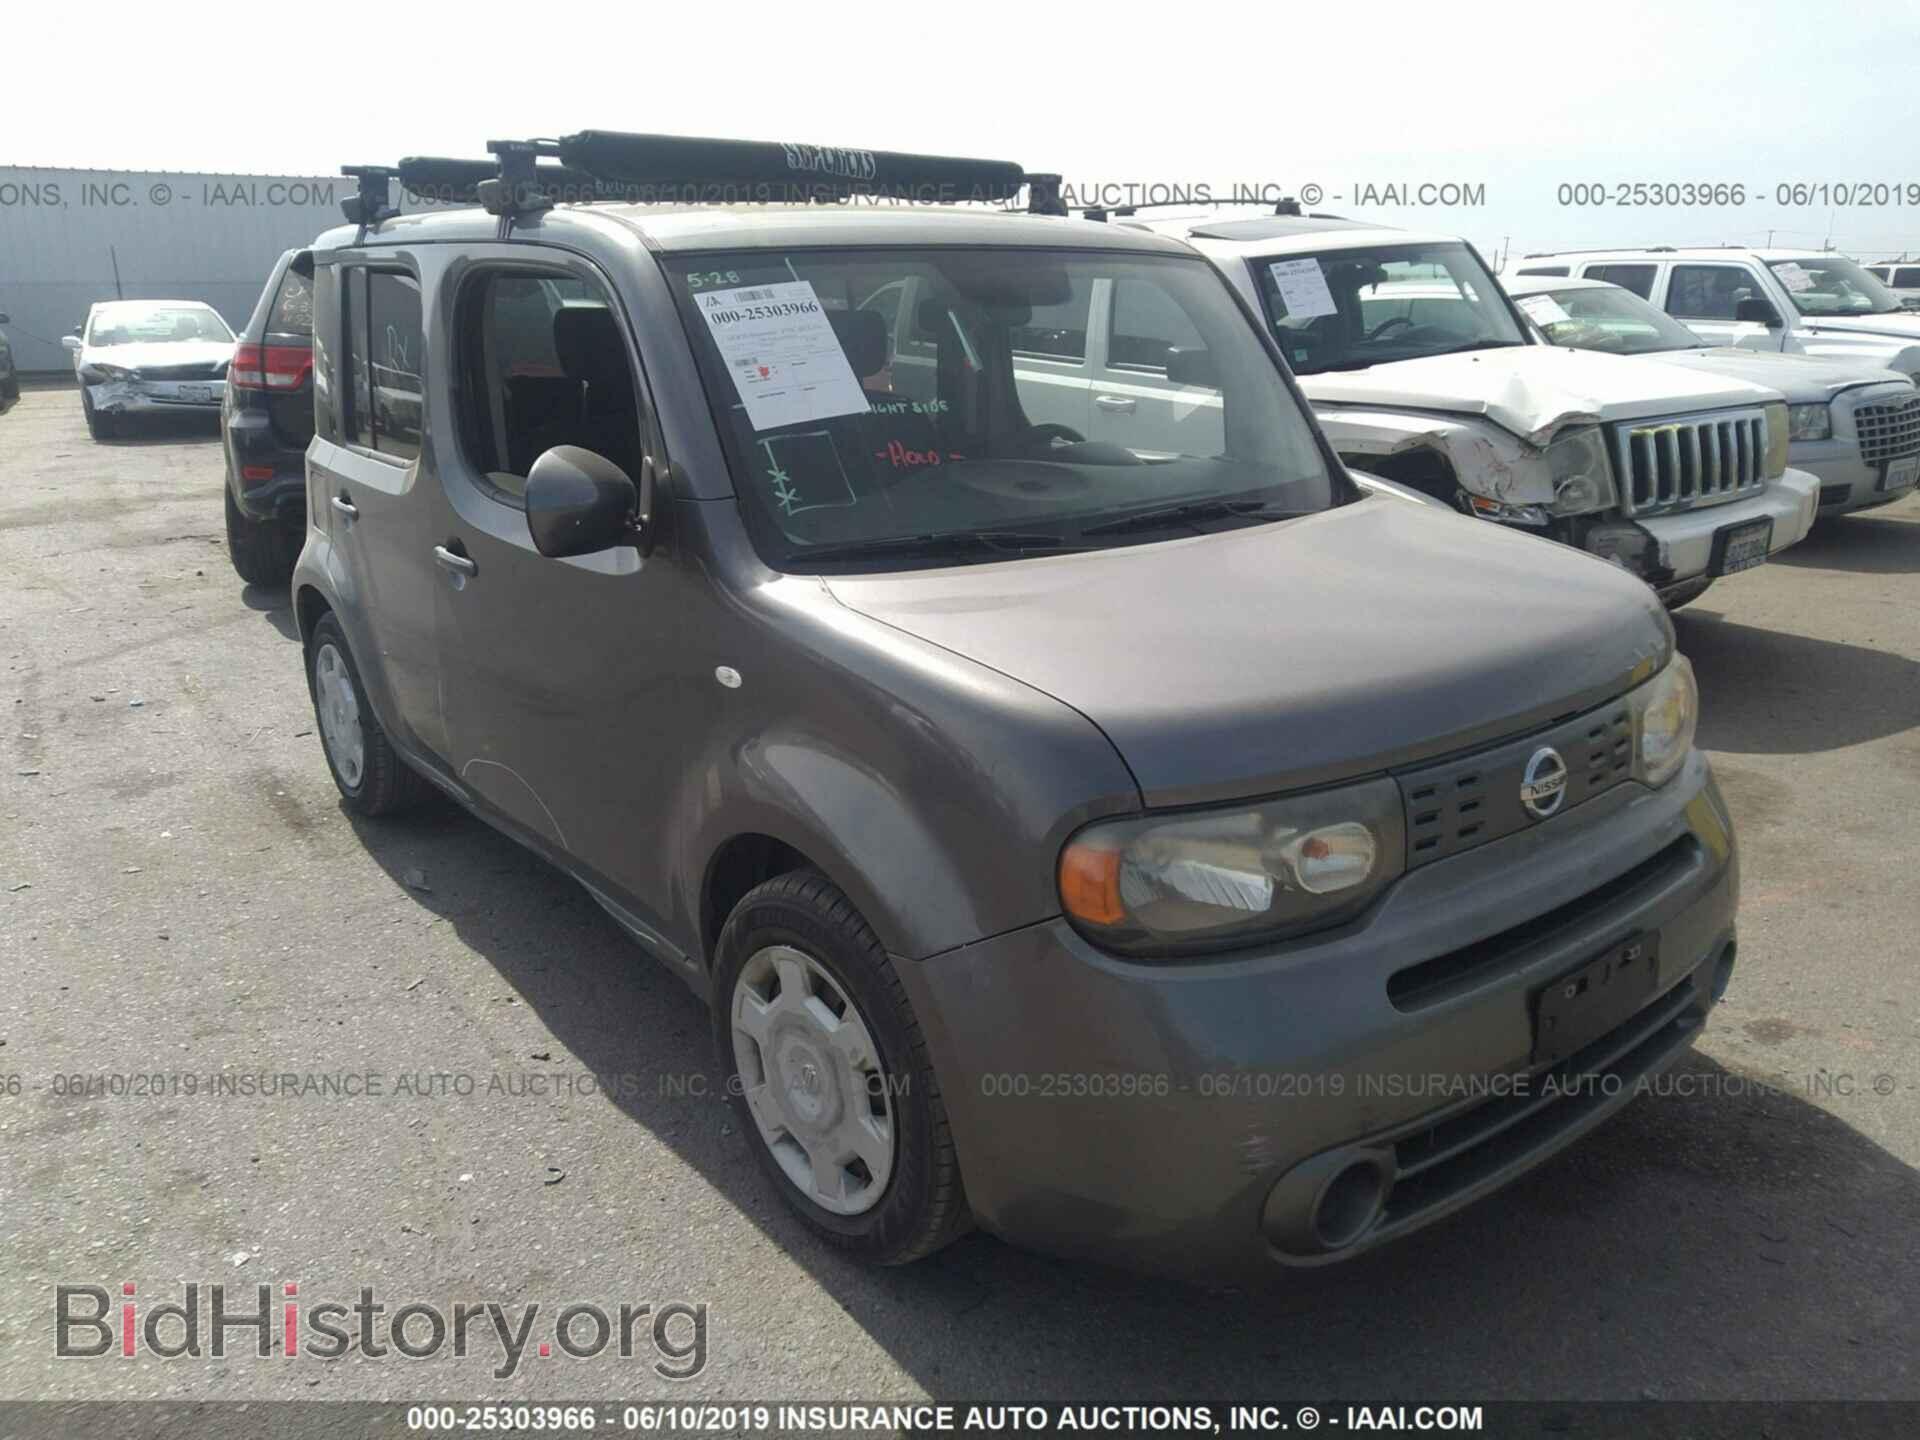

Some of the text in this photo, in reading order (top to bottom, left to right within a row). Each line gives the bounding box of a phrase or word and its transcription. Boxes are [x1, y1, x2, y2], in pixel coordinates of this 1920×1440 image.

[710, 300, 818, 325] 000-25303966
[866, 400, 948, 415] IGHT SIDE
